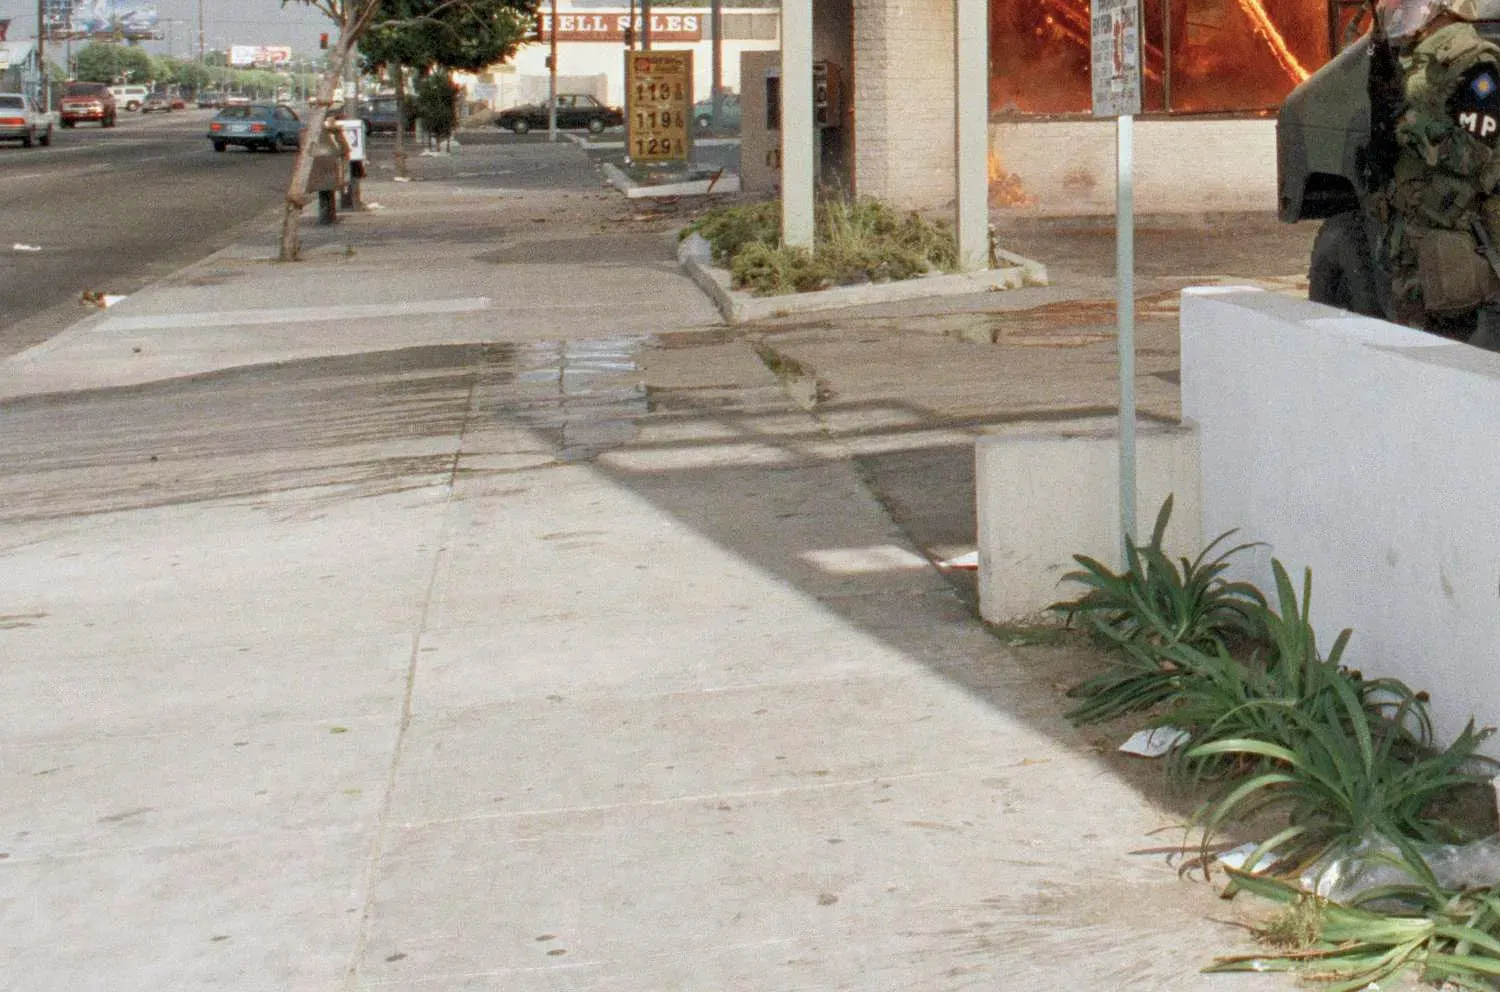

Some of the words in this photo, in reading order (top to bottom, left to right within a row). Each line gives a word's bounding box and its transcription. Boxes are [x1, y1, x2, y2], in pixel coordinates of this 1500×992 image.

[636, 111, 671, 129] 119
[1459, 112, 1497, 137] MP
[635, 138, 671, 155] 129
